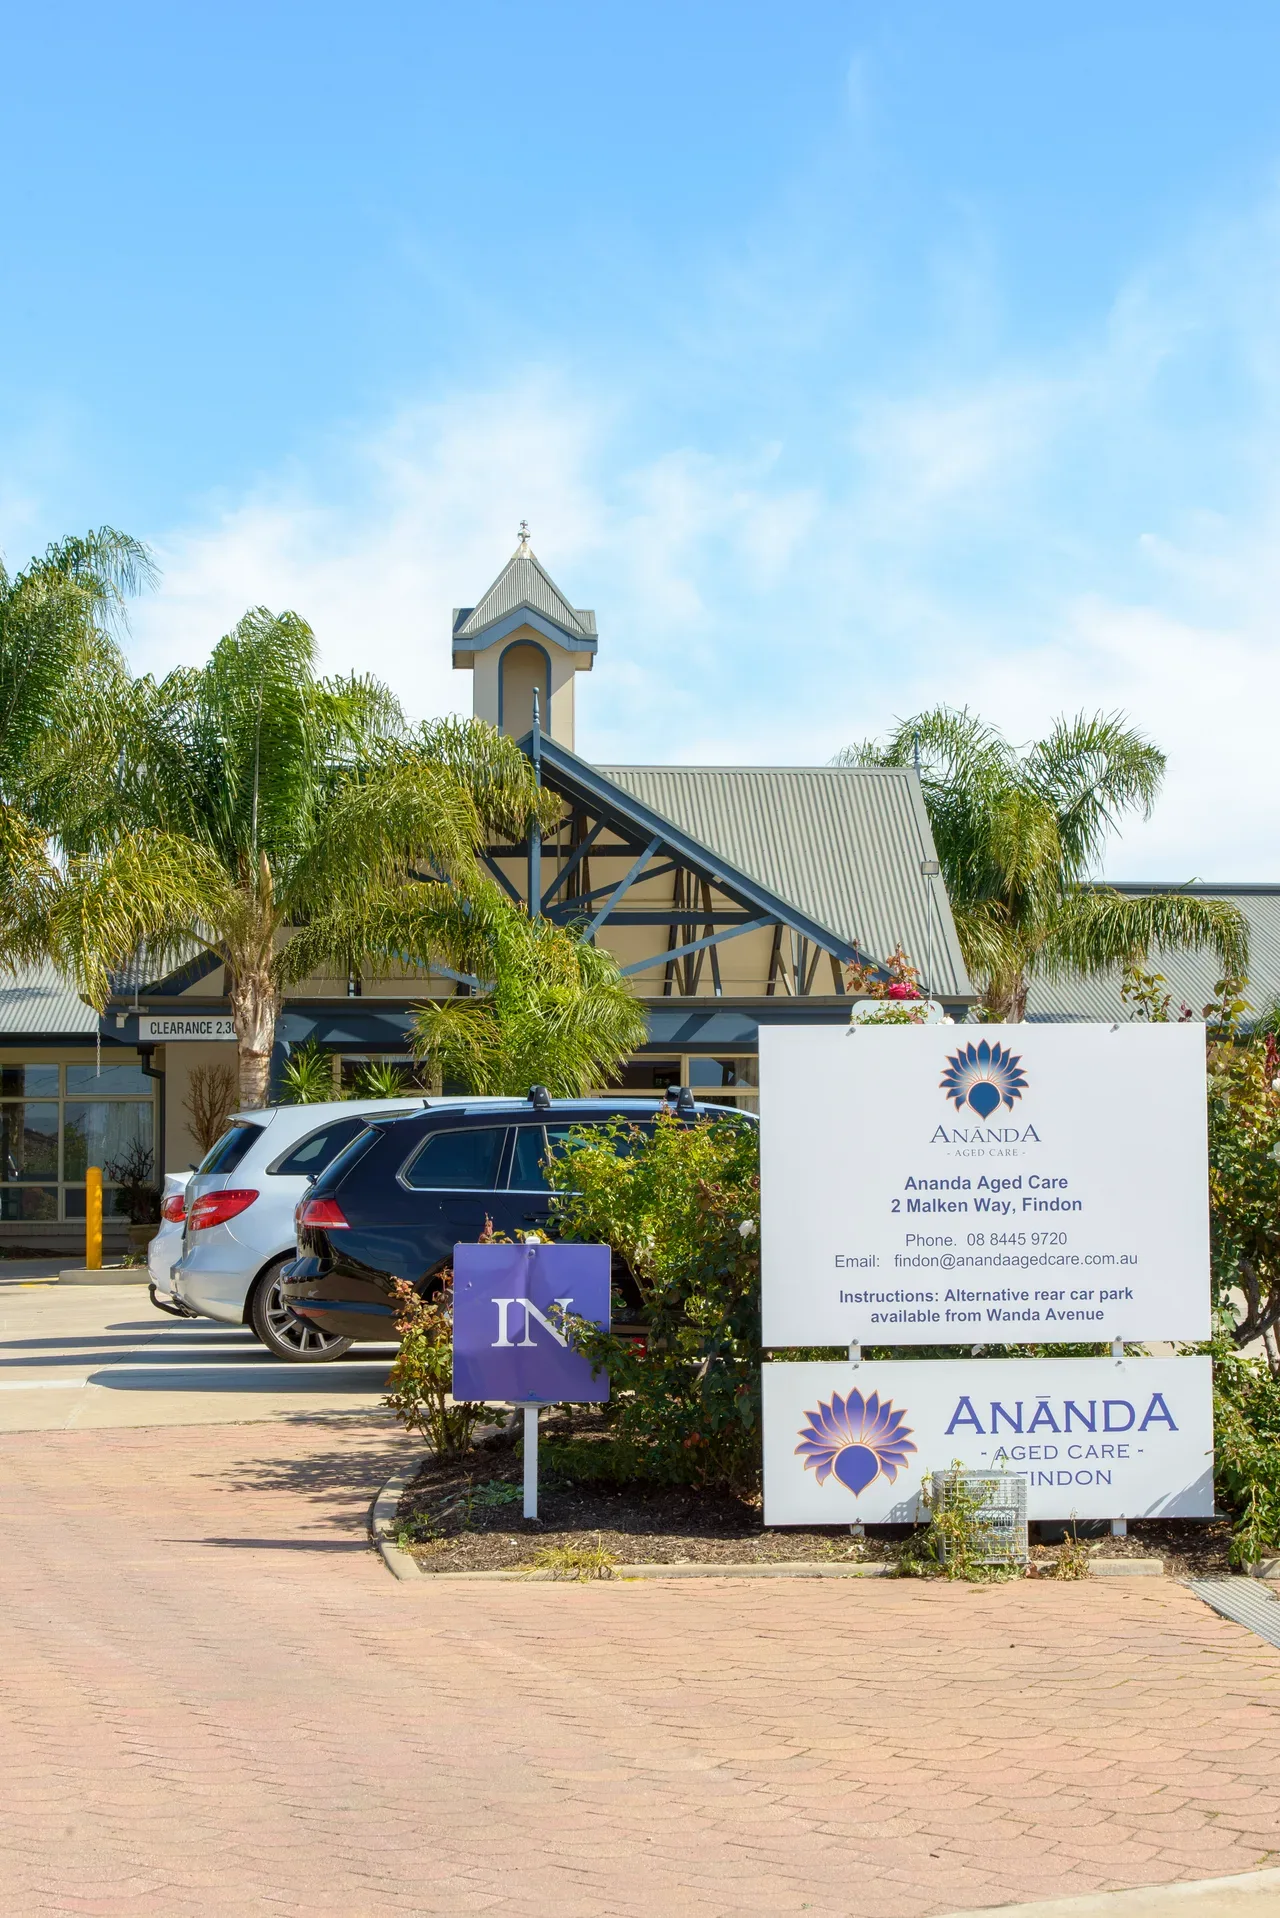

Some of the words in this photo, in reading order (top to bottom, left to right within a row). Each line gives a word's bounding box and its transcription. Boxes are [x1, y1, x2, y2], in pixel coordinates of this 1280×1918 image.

[150, 1021, 213, 1035] CLEARANCE
[954, 1148, 985, 1157] AGED
[988, 1148, 1018, 1157] CARE
[904, 1175, 972, 1191] Ananda
[977, 1174, 1022, 1194] Aged
[1027, 1174, 1069, 1190] Care
[890, 1198, 901, 1213] 2
[906, 1197, 969, 1213] Malken
[973, 1197, 1016, 1216] Way,
[1022, 1196, 1083, 1212] Findon
[905, 1233, 957, 1247] Phone.
[966, 1232, 985, 1247] 08
[989, 1232, 1027, 1247] 8445
[1030, 1231, 1068, 1246] 9720
[834, 1254, 880, 1268] Email:
[893, 1252, 1138, 1271] findon@anandaagedcare.com.au
[839, 1289, 939, 1304] Instructions:
[943, 1287, 1030, 1302] Alternative
[1034, 1290, 1066, 1301] rear
[1069, 1289, 1095, 1301] car
[1099, 1286, 1134, 1304] park
[491, 1298, 574, 1348] IN
[870, 1309, 941, 1324] available
[944, 1308, 982, 1323] from
[985, 1307, 1041, 1322] Wanda
[1044, 1307, 1105, 1321] Avenue
[994, 1445, 1059, 1461] AGED
[1067, 1443, 1130, 1460] CARE
[1016, 1469, 1112, 1487] INDON
